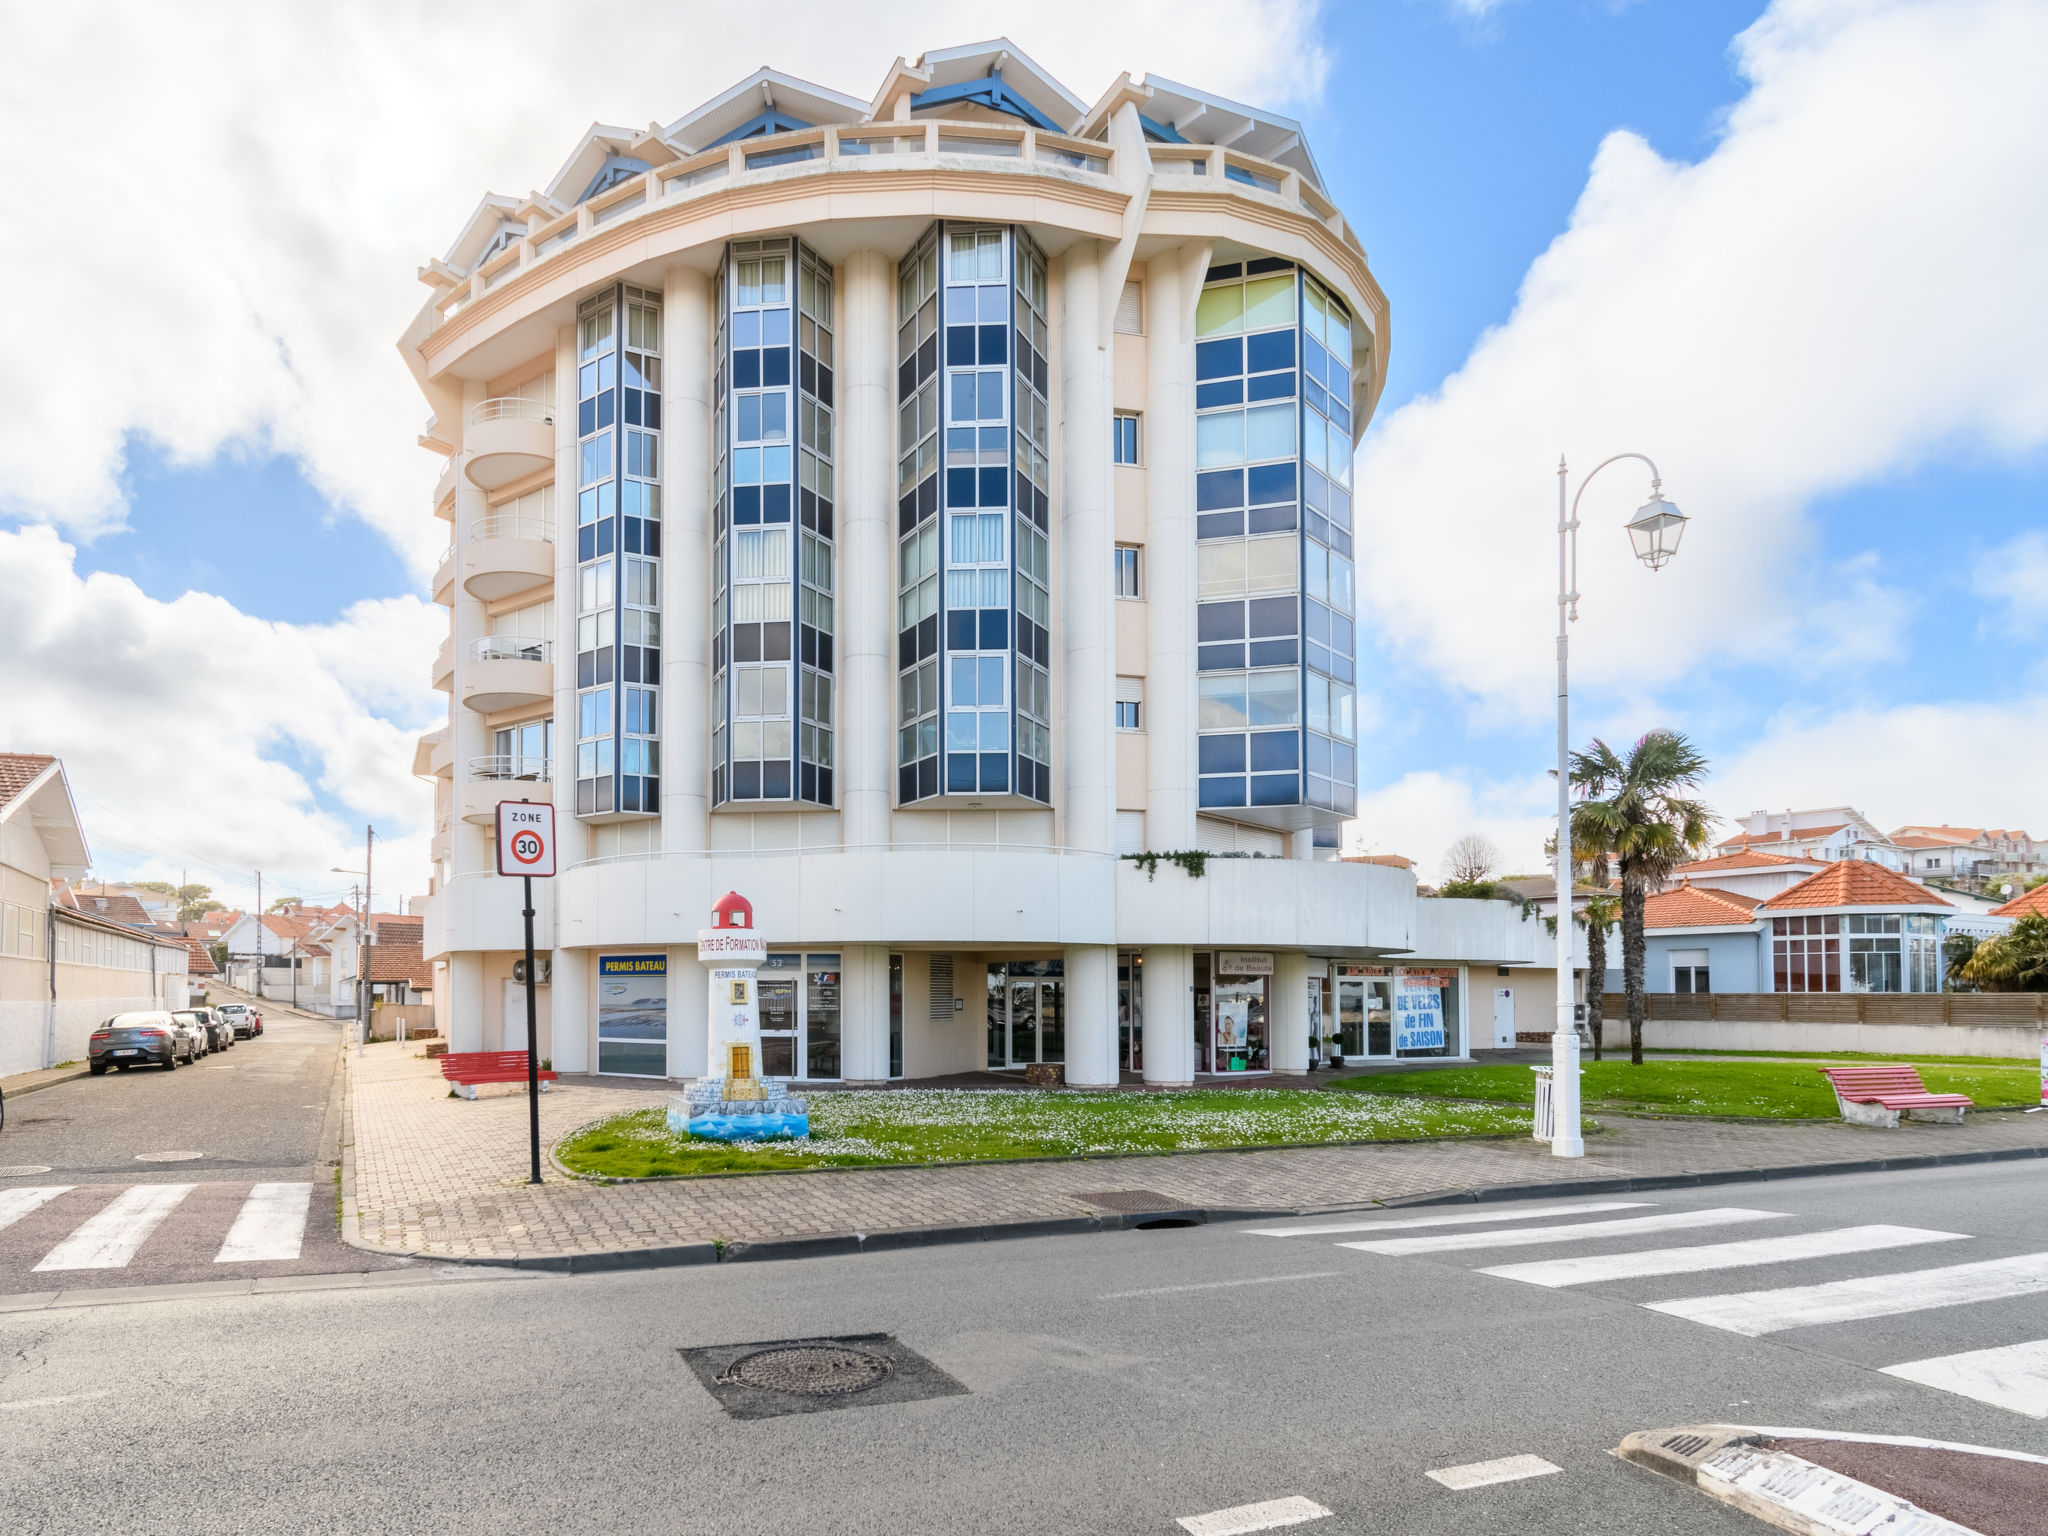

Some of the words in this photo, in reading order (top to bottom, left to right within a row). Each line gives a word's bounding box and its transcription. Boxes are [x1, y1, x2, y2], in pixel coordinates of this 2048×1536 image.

[512, 812, 542, 823] ZONE
[518, 840, 538, 854] 30
[715, 938, 724, 951] DE
[605, 961, 634, 972] PERMIS
[635, 960, 665, 971] BATEAU
[771, 959, 783, 967] 52
[714, 970, 736, 979] PERMIS
[1397, 995, 1409, 1011] DE
[1404, 1013, 1416, 1029] de
[1418, 1012, 1435, 1028] FIN
[1398, 1033, 1409, 1048] de
[1410, 1030, 1443, 1047] SAISON
